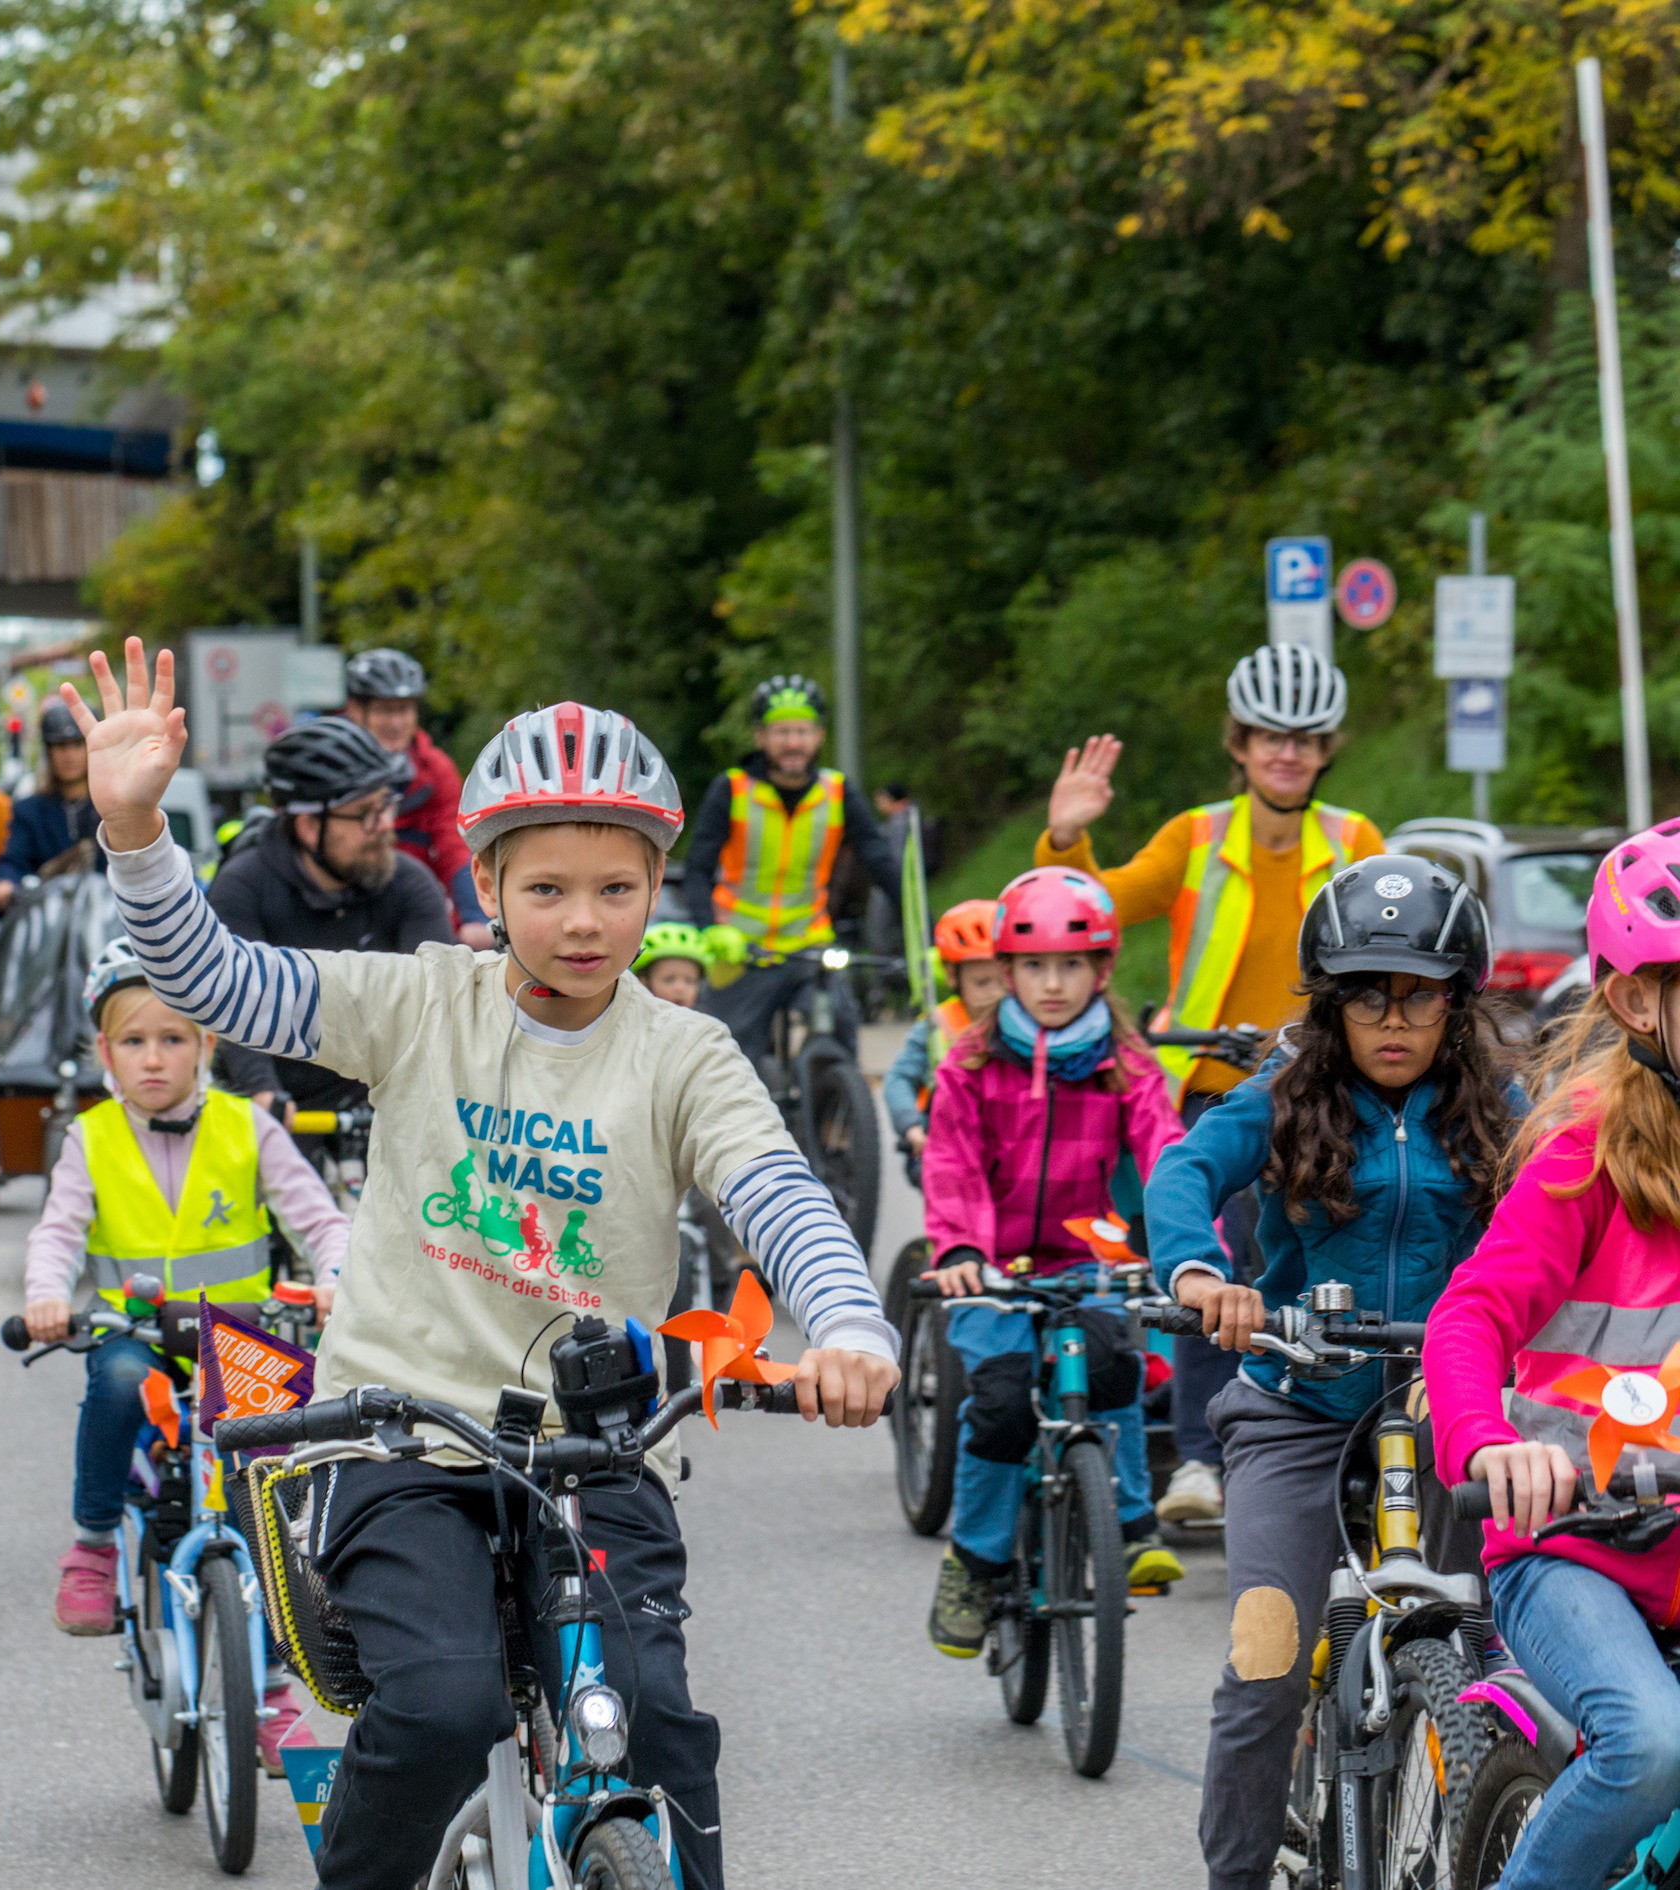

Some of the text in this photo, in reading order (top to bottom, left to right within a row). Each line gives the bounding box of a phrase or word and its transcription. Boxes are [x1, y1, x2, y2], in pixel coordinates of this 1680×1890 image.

[457, 1098, 608, 1155] KIDICAL
[488, 1149, 603, 1205] MASS
[448, 1251, 510, 1288] gehört
[512, 1279, 543, 1298] die
[547, 1284, 601, 1309] Straße
[226, 1340, 266, 1371] FÜR
[254, 1354, 294, 1384] DIE
